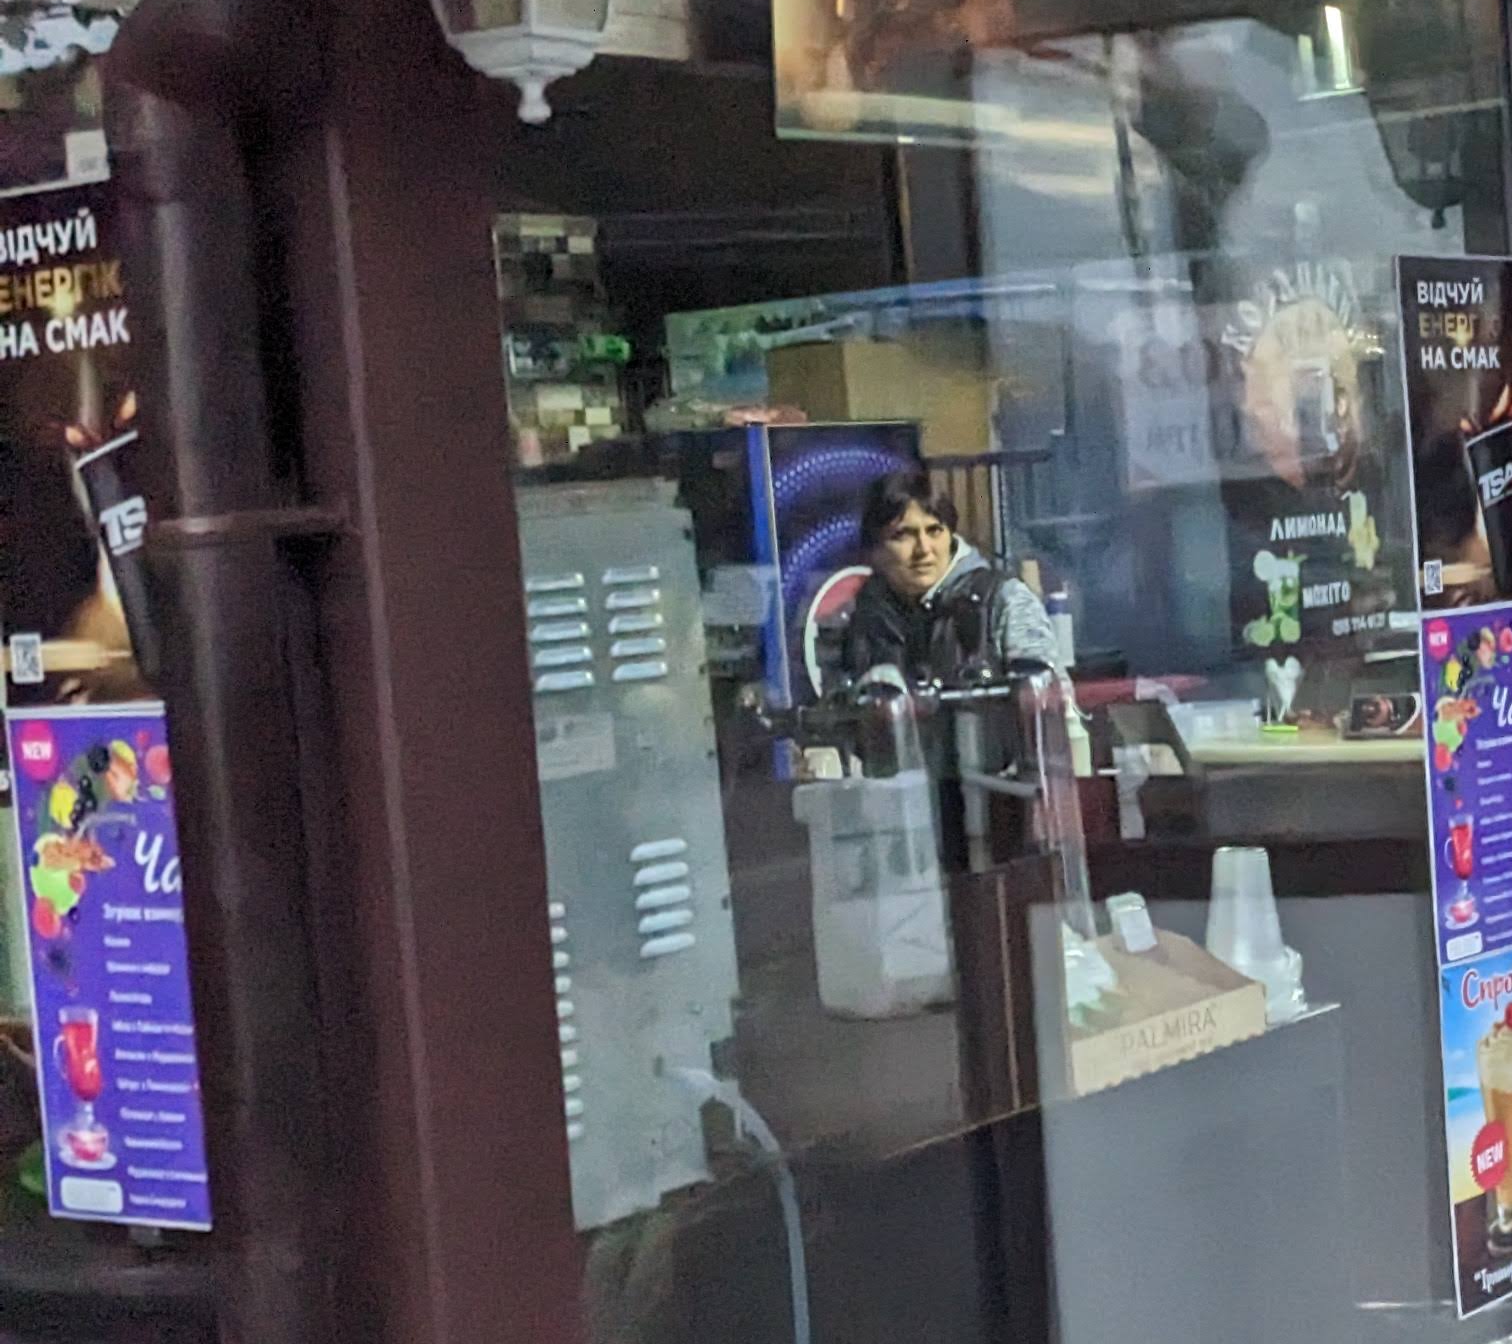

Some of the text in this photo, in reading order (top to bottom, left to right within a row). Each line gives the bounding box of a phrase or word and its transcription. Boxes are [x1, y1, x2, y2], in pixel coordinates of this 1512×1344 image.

[1416, 277, 1484, 308] ВІДЧУЙ
[0, 306, 131, 360] НА СМАК
[1420, 346, 1501, 370] НА СМАК
[99, 495, 148, 549] TS
[21, 741, 52, 760] NEW
[134, 830, 184, 894] Ча
[1475, 1139, 1505, 1174] NEW
